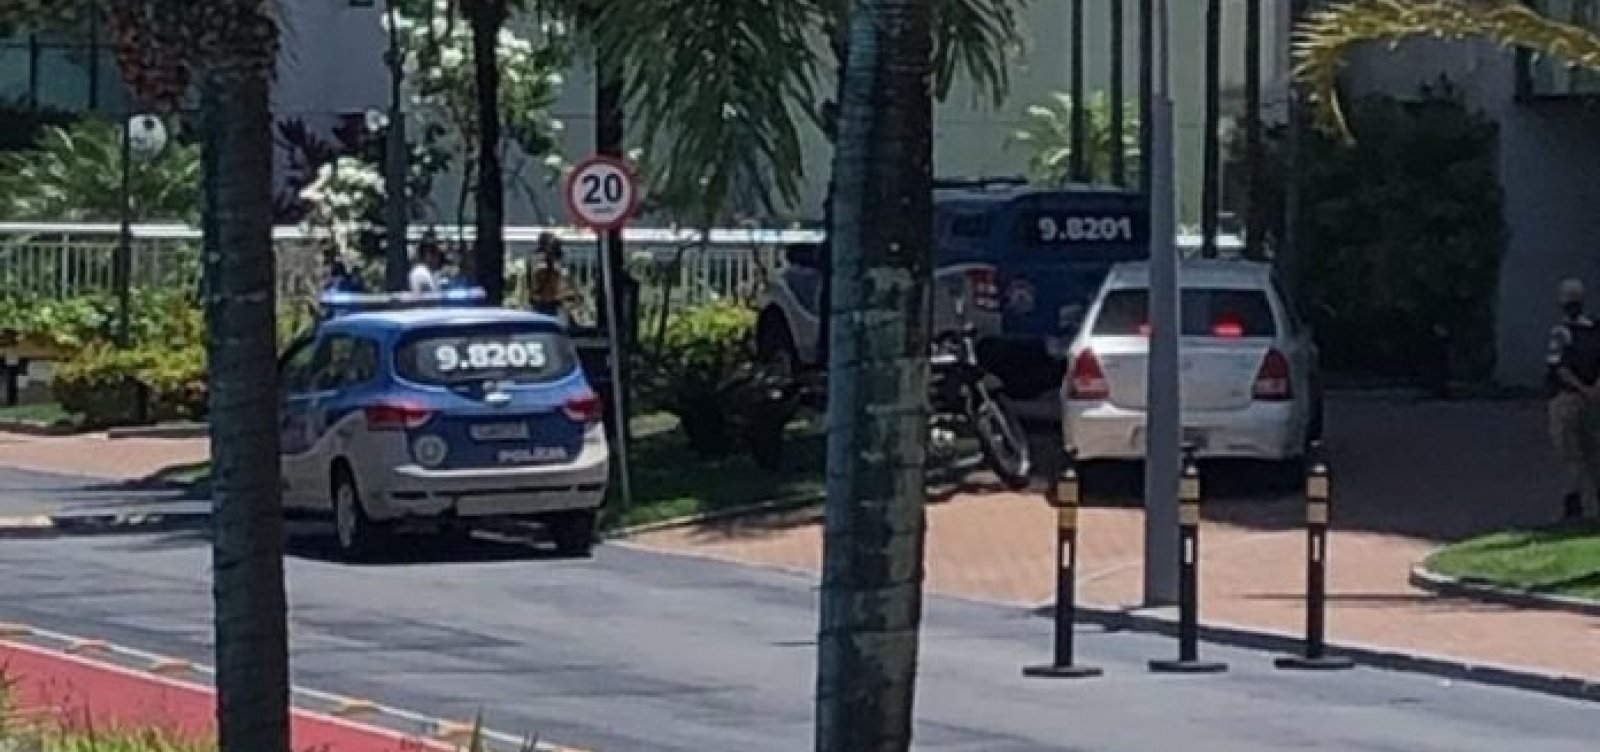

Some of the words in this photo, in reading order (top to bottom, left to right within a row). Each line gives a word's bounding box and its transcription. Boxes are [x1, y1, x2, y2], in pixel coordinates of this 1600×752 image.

[582, 173, 623, 204] 20
[1038, 216, 1131, 240] 9.8201
[436, 342, 545, 371] 9.8205
